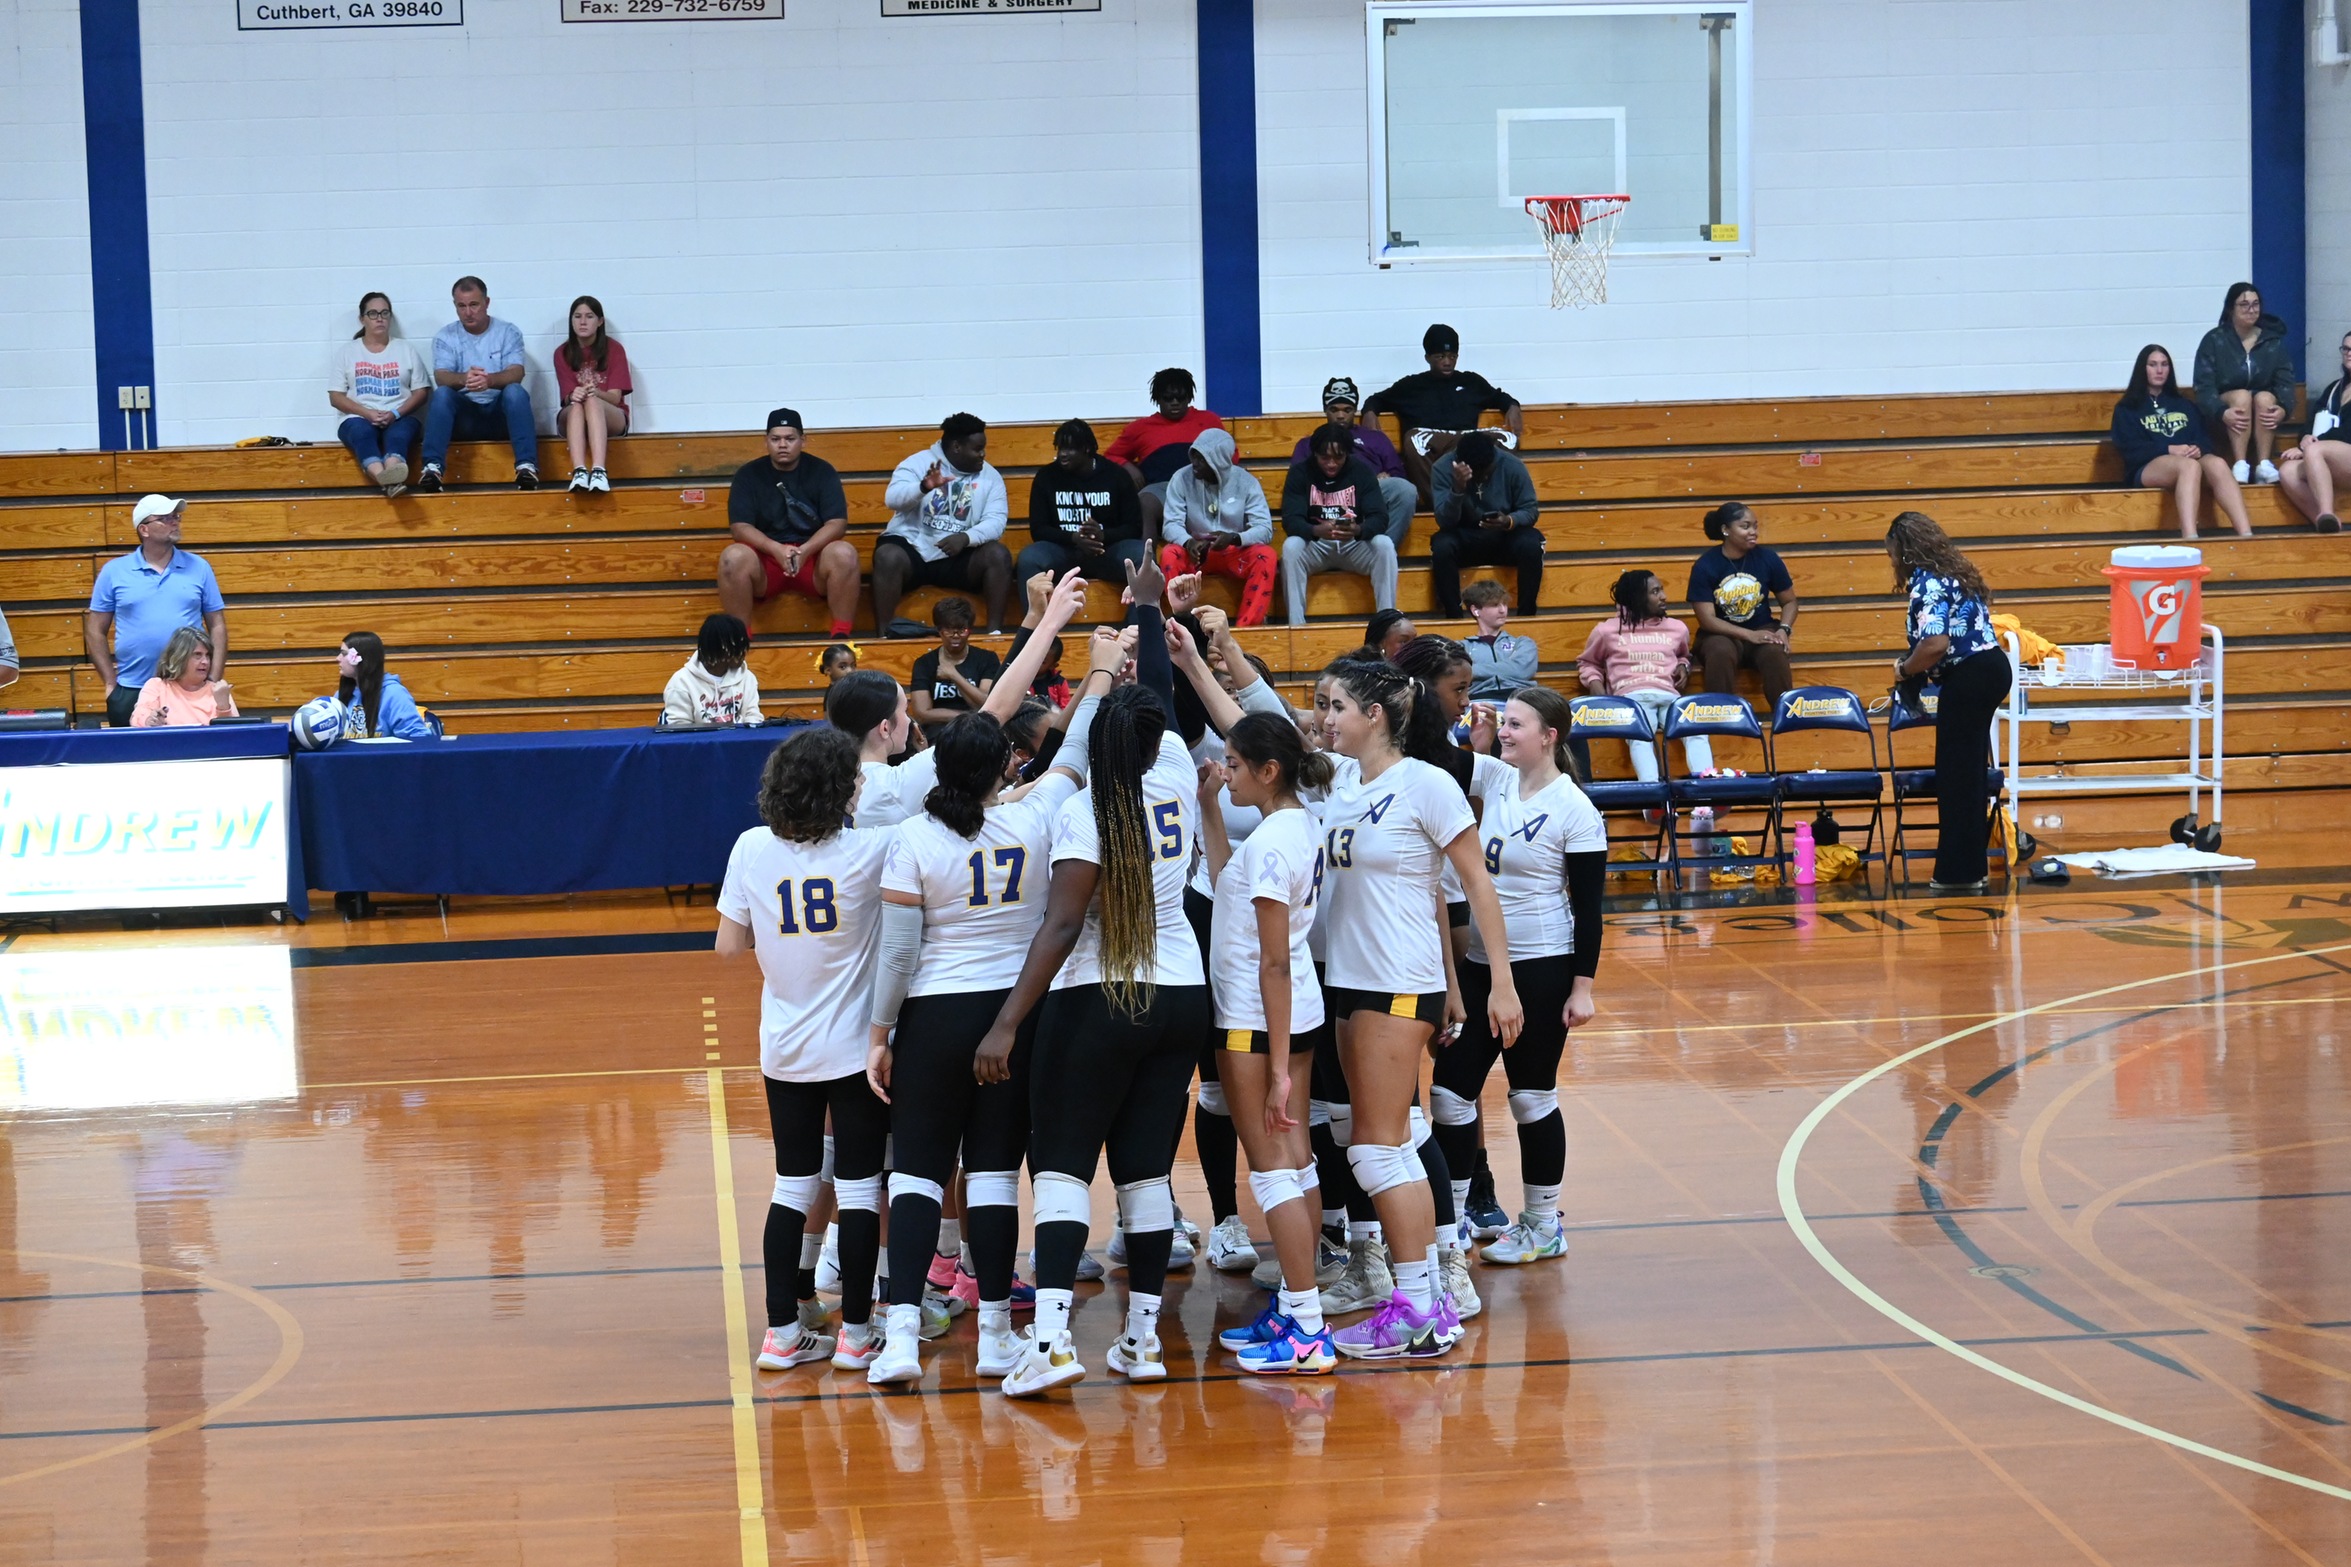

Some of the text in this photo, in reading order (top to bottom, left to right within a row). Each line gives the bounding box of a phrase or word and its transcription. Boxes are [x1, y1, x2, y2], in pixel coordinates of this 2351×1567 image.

[257, 2, 443, 21] Cuthbert, GA 39840
[580, 0, 766, 14] Fax: 229-732-6759
[908, 0, 980, 10] MEDICINE
[988, 0, 998, 8] &
[355, 369, 400, 380] NORMAN PARK
[1085, 492, 1111, 506] YOUR
[2148, 585, 2176, 615] G
[1617, 632, 1673, 647] A humble
[1627, 649, 1665, 661] human
[1630, 660, 1656, 673] with
[1677, 702, 1743, 723] ANDREW
[1784, 696, 1851, 718] ANDREW
[1327, 827, 1356, 869] 13
[1484, 836, 1504, 876] 9
[967, 845, 1028, 908] 17
[776, 876, 839, 936] 18
